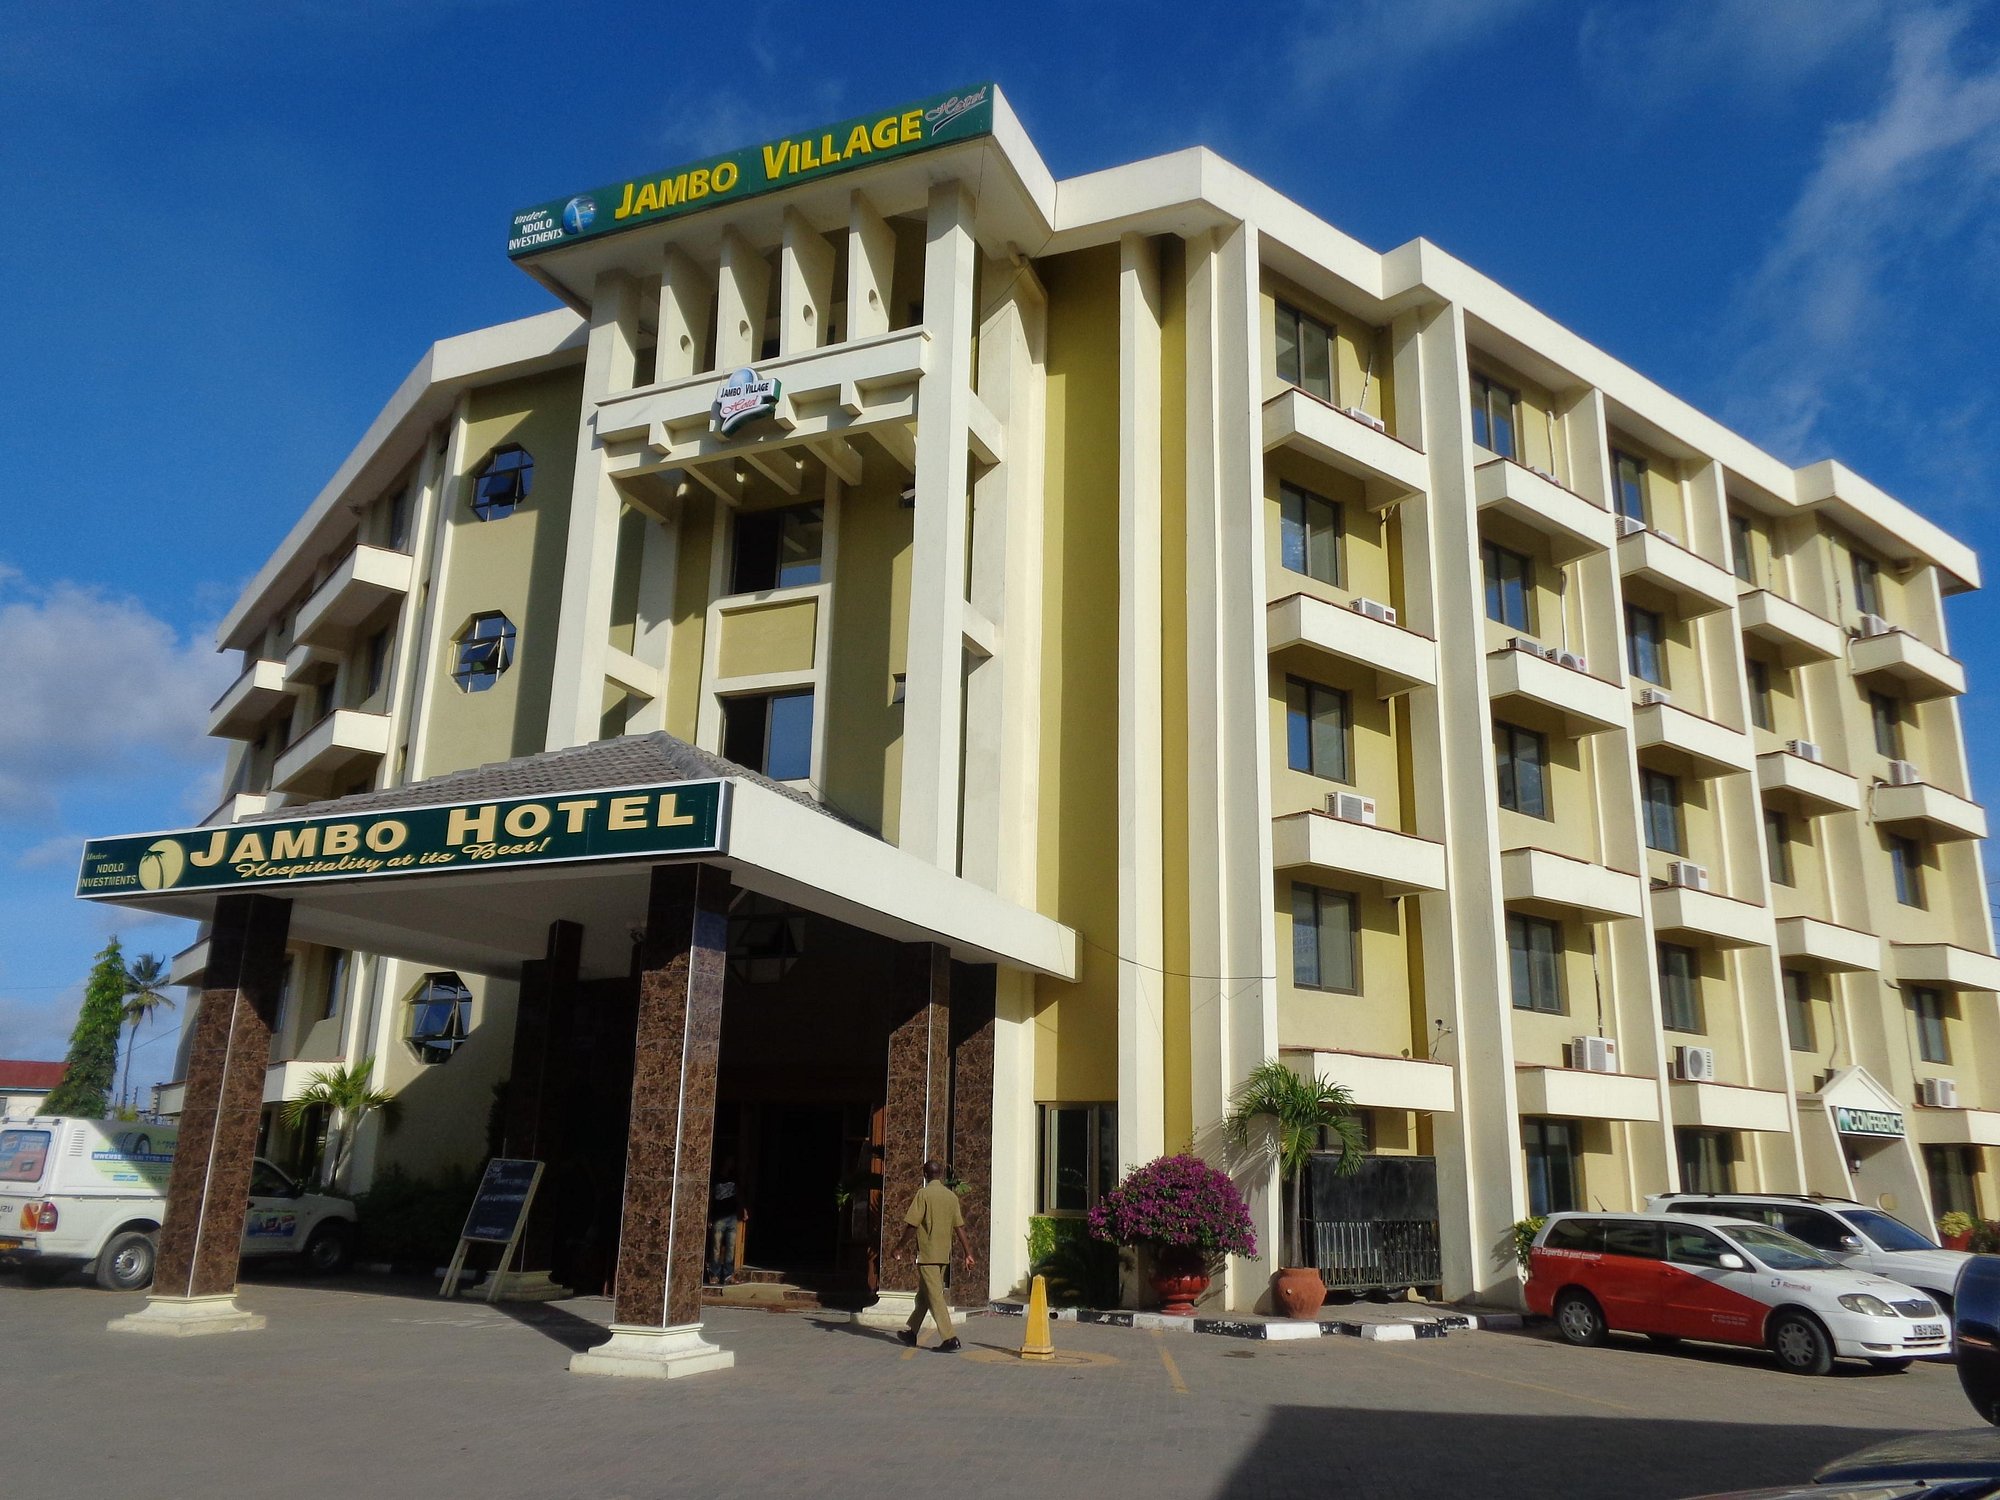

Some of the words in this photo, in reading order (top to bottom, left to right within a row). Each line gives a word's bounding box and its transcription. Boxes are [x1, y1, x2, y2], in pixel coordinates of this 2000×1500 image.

[615, 162, 738, 219] JAMBO
[763, 109, 923, 180] VILLAGE
[522, 218, 553, 234] NDOLO
[508, 228, 563, 250] INVESTMENTS
[720, 387, 741, 398] JAMBO
[745, 382, 769, 394] VILLAGE
[189, 820, 407, 867] JAMBO
[446, 793, 694, 845] HOTEL
[235, 855, 383, 879] Hospitality
[386, 852, 415, 867] at
[418, 851, 455, 865] its
[461, 837, 551, 860] Best!
[96, 863, 124, 873] NDOLO
[80, 875, 137, 888] INVESTMENTS
